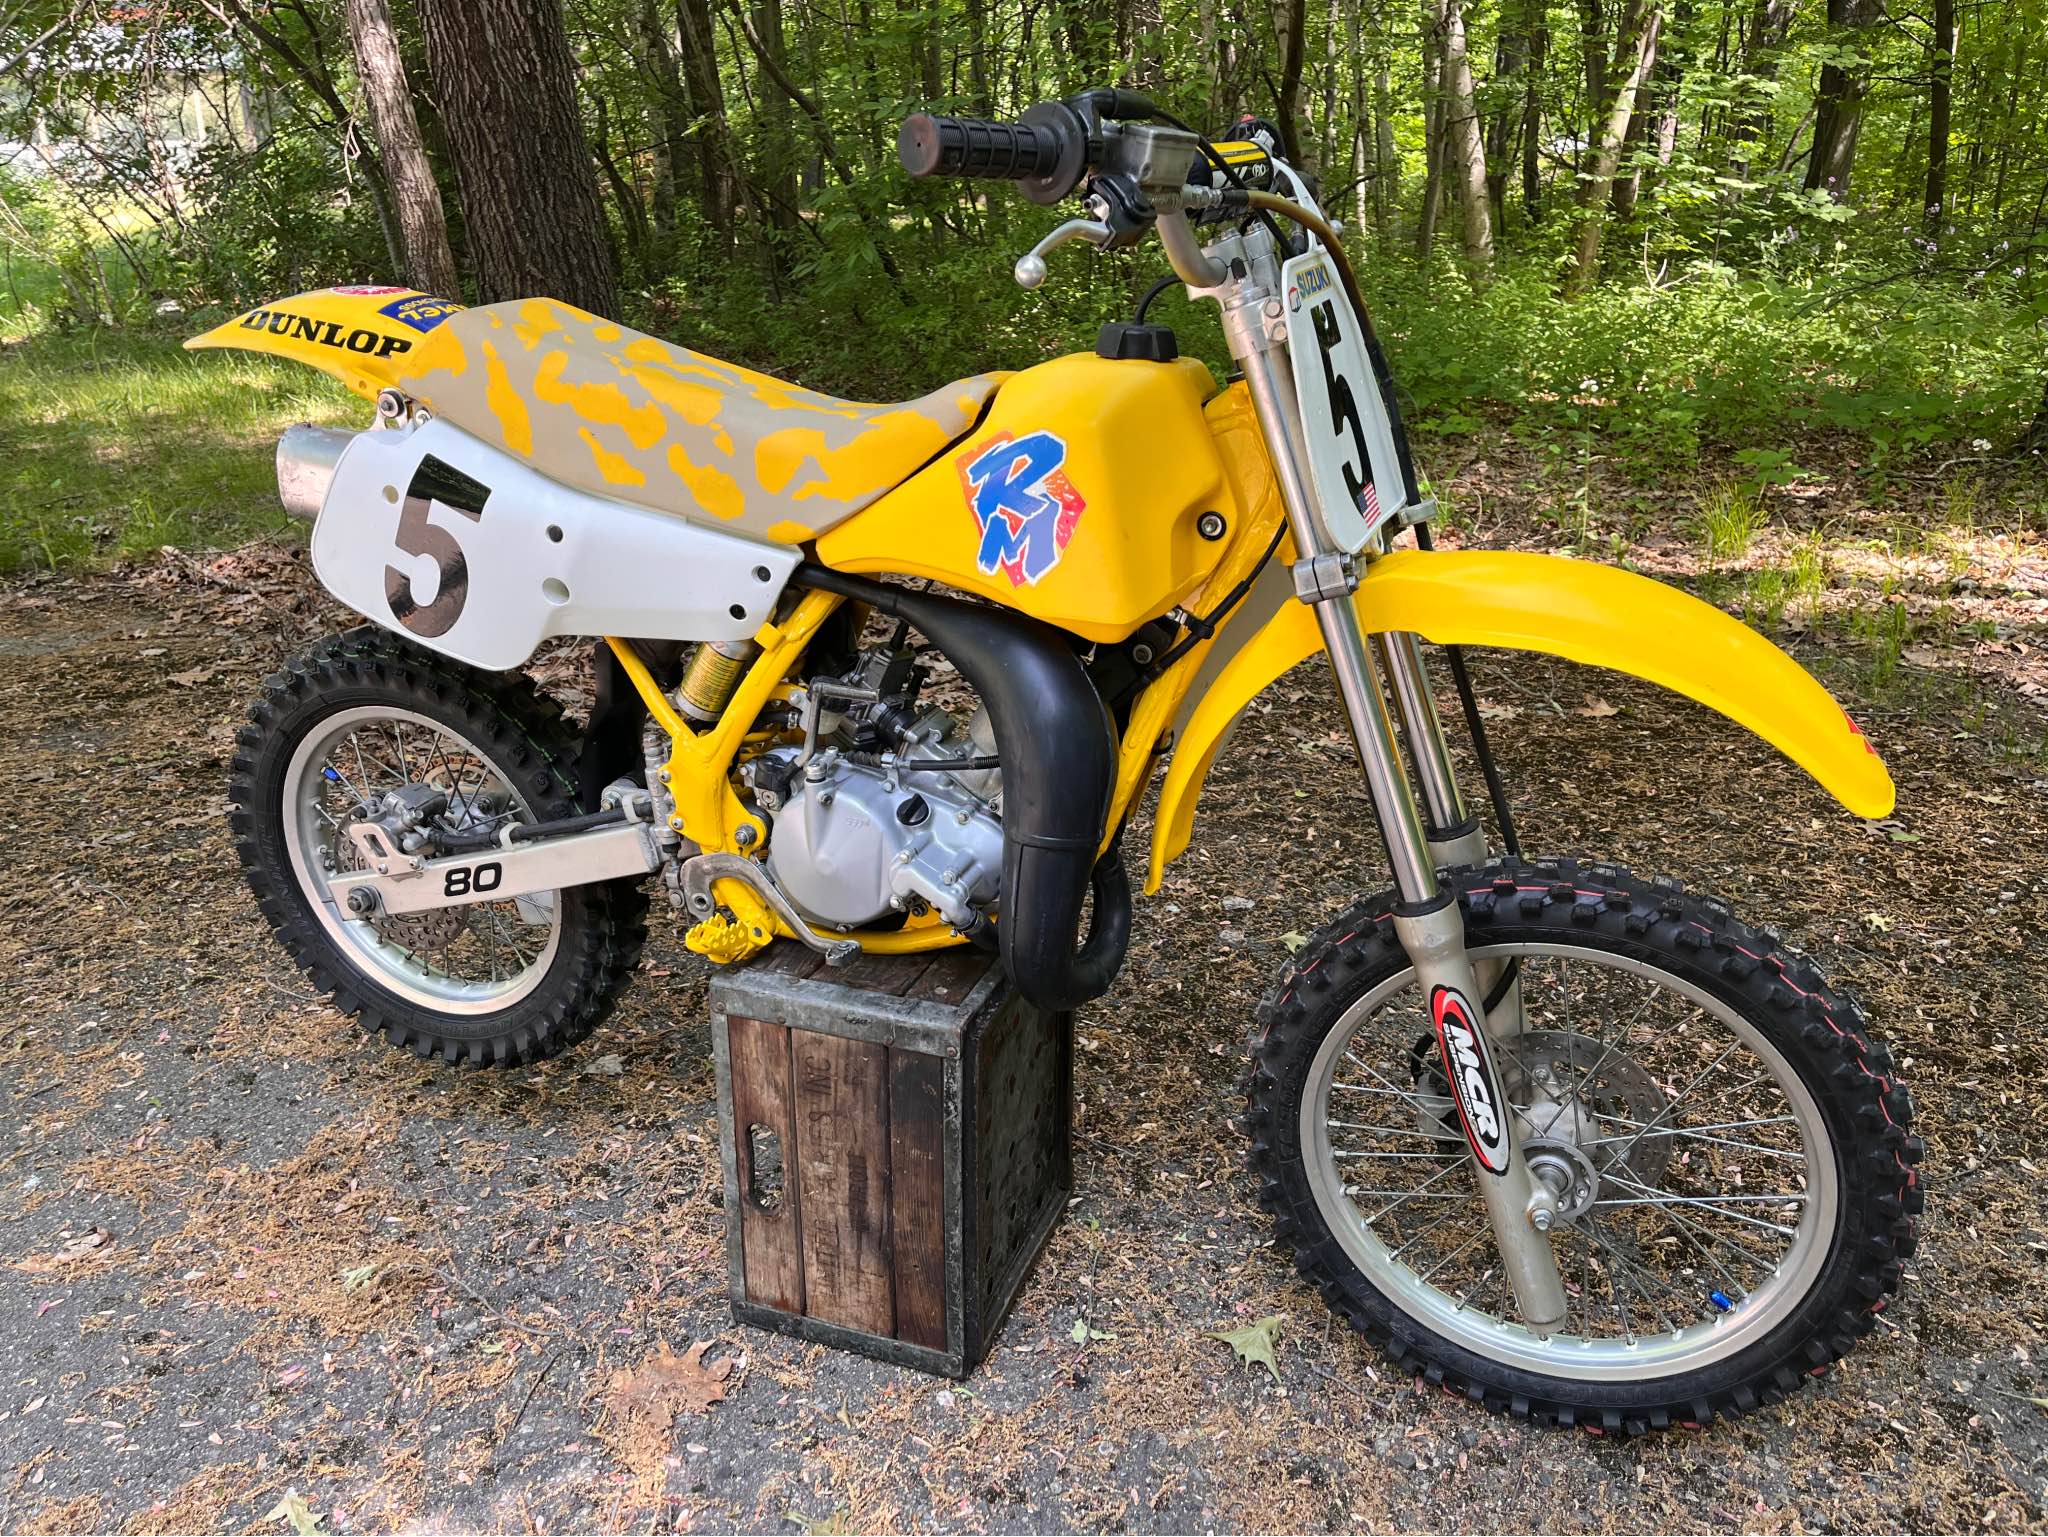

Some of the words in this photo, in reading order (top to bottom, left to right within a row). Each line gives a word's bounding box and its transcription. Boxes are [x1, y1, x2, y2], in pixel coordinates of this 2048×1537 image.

[1295, 264, 1332, 298] SUZUKI
[240, 310, 413, 359] DUNLOP
[1310, 299, 1375, 519] 5
[384, 453, 492, 638] 5
[966, 429, 1067, 587] RM
[444, 862, 502, 897] 80
[804, 1056, 832, 1096] INC
[1449, 1024, 1499, 1139] MCR
